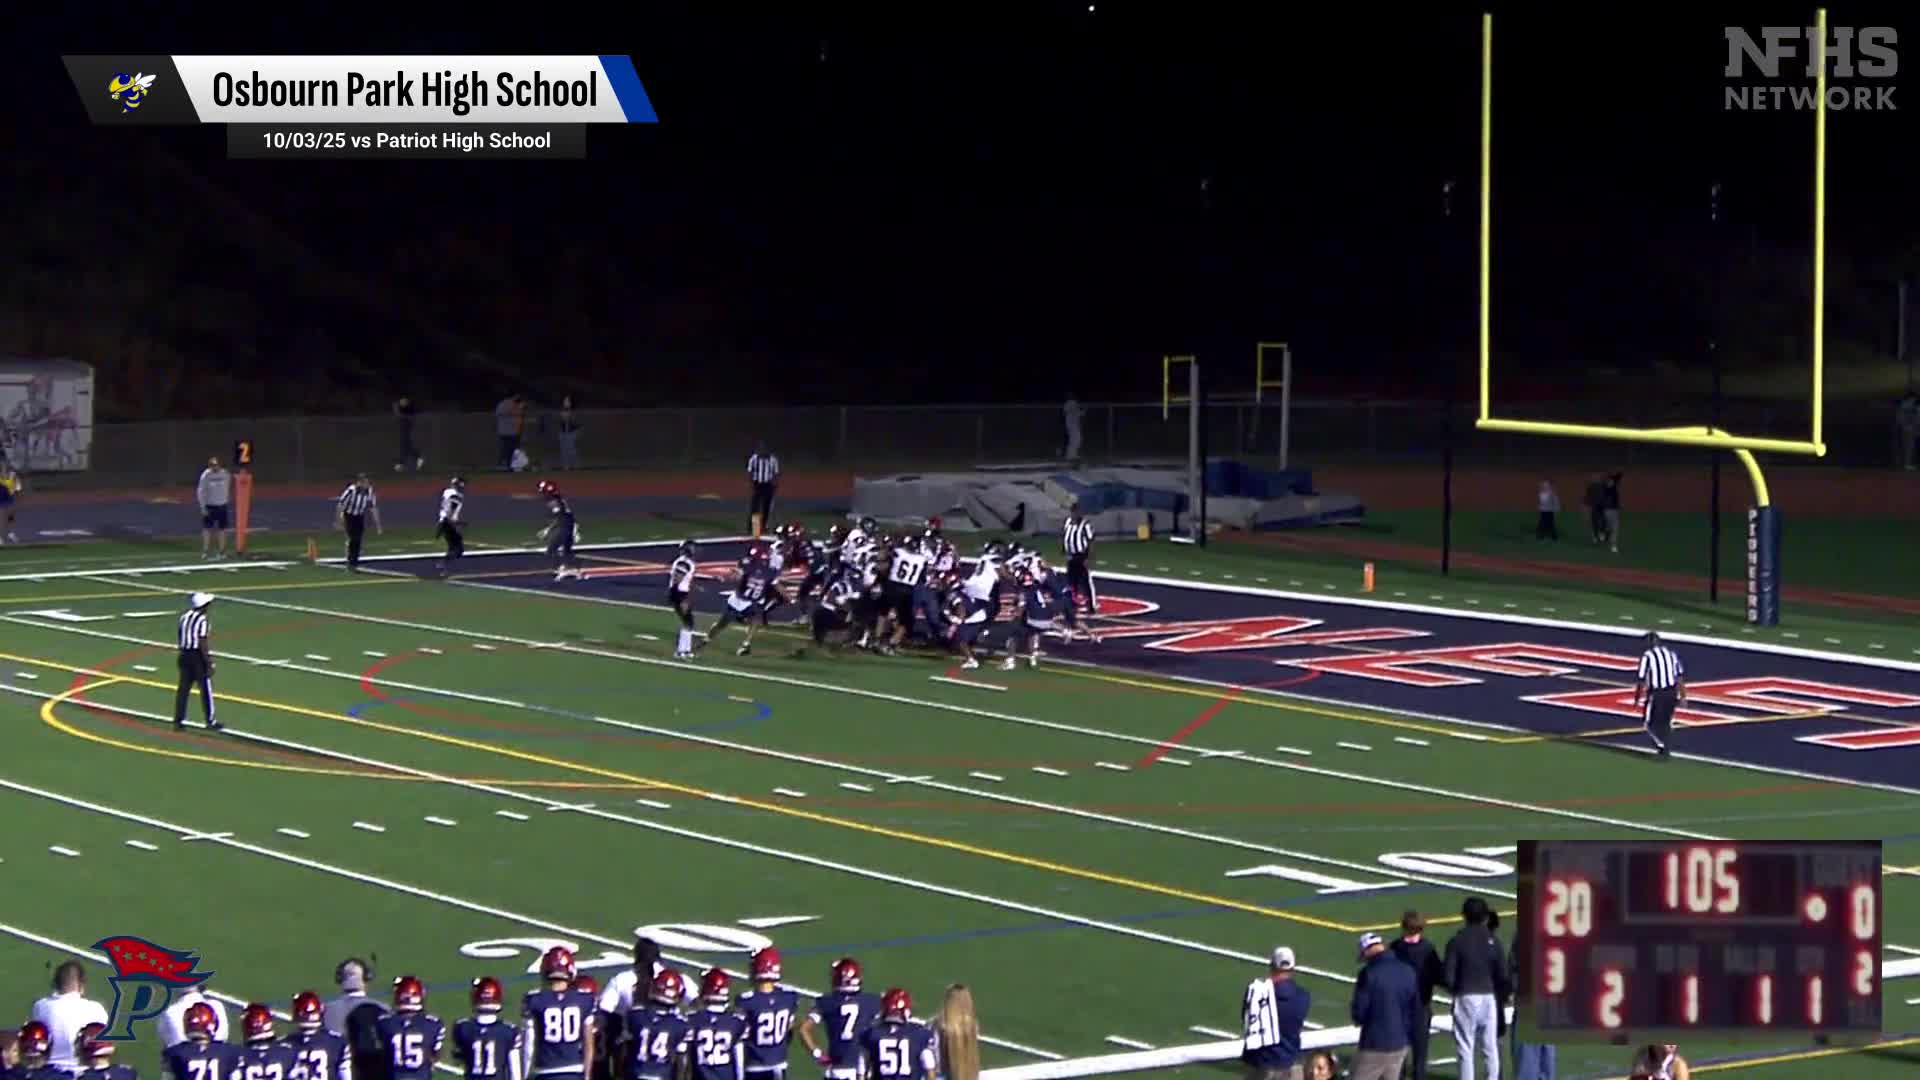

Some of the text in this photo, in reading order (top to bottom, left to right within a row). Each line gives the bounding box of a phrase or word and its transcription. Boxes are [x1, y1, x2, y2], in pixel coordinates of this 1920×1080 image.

[238, 442, 250, 463] 2
[897, 561, 920, 582] 61
[544, 1006, 581, 1043] 80
[757, 1010, 788, 1045] 20
[840, 1004, 859, 1039] 7
[391, 1034, 424, 1068] 15
[471, 1040, 497, 1074] 11
[637, 1028, 669, 1062] 14
[698, 1029, 731, 1064] 22
[879, 1038, 910, 1075] 51
[188, 1058, 219, 1080] 71
